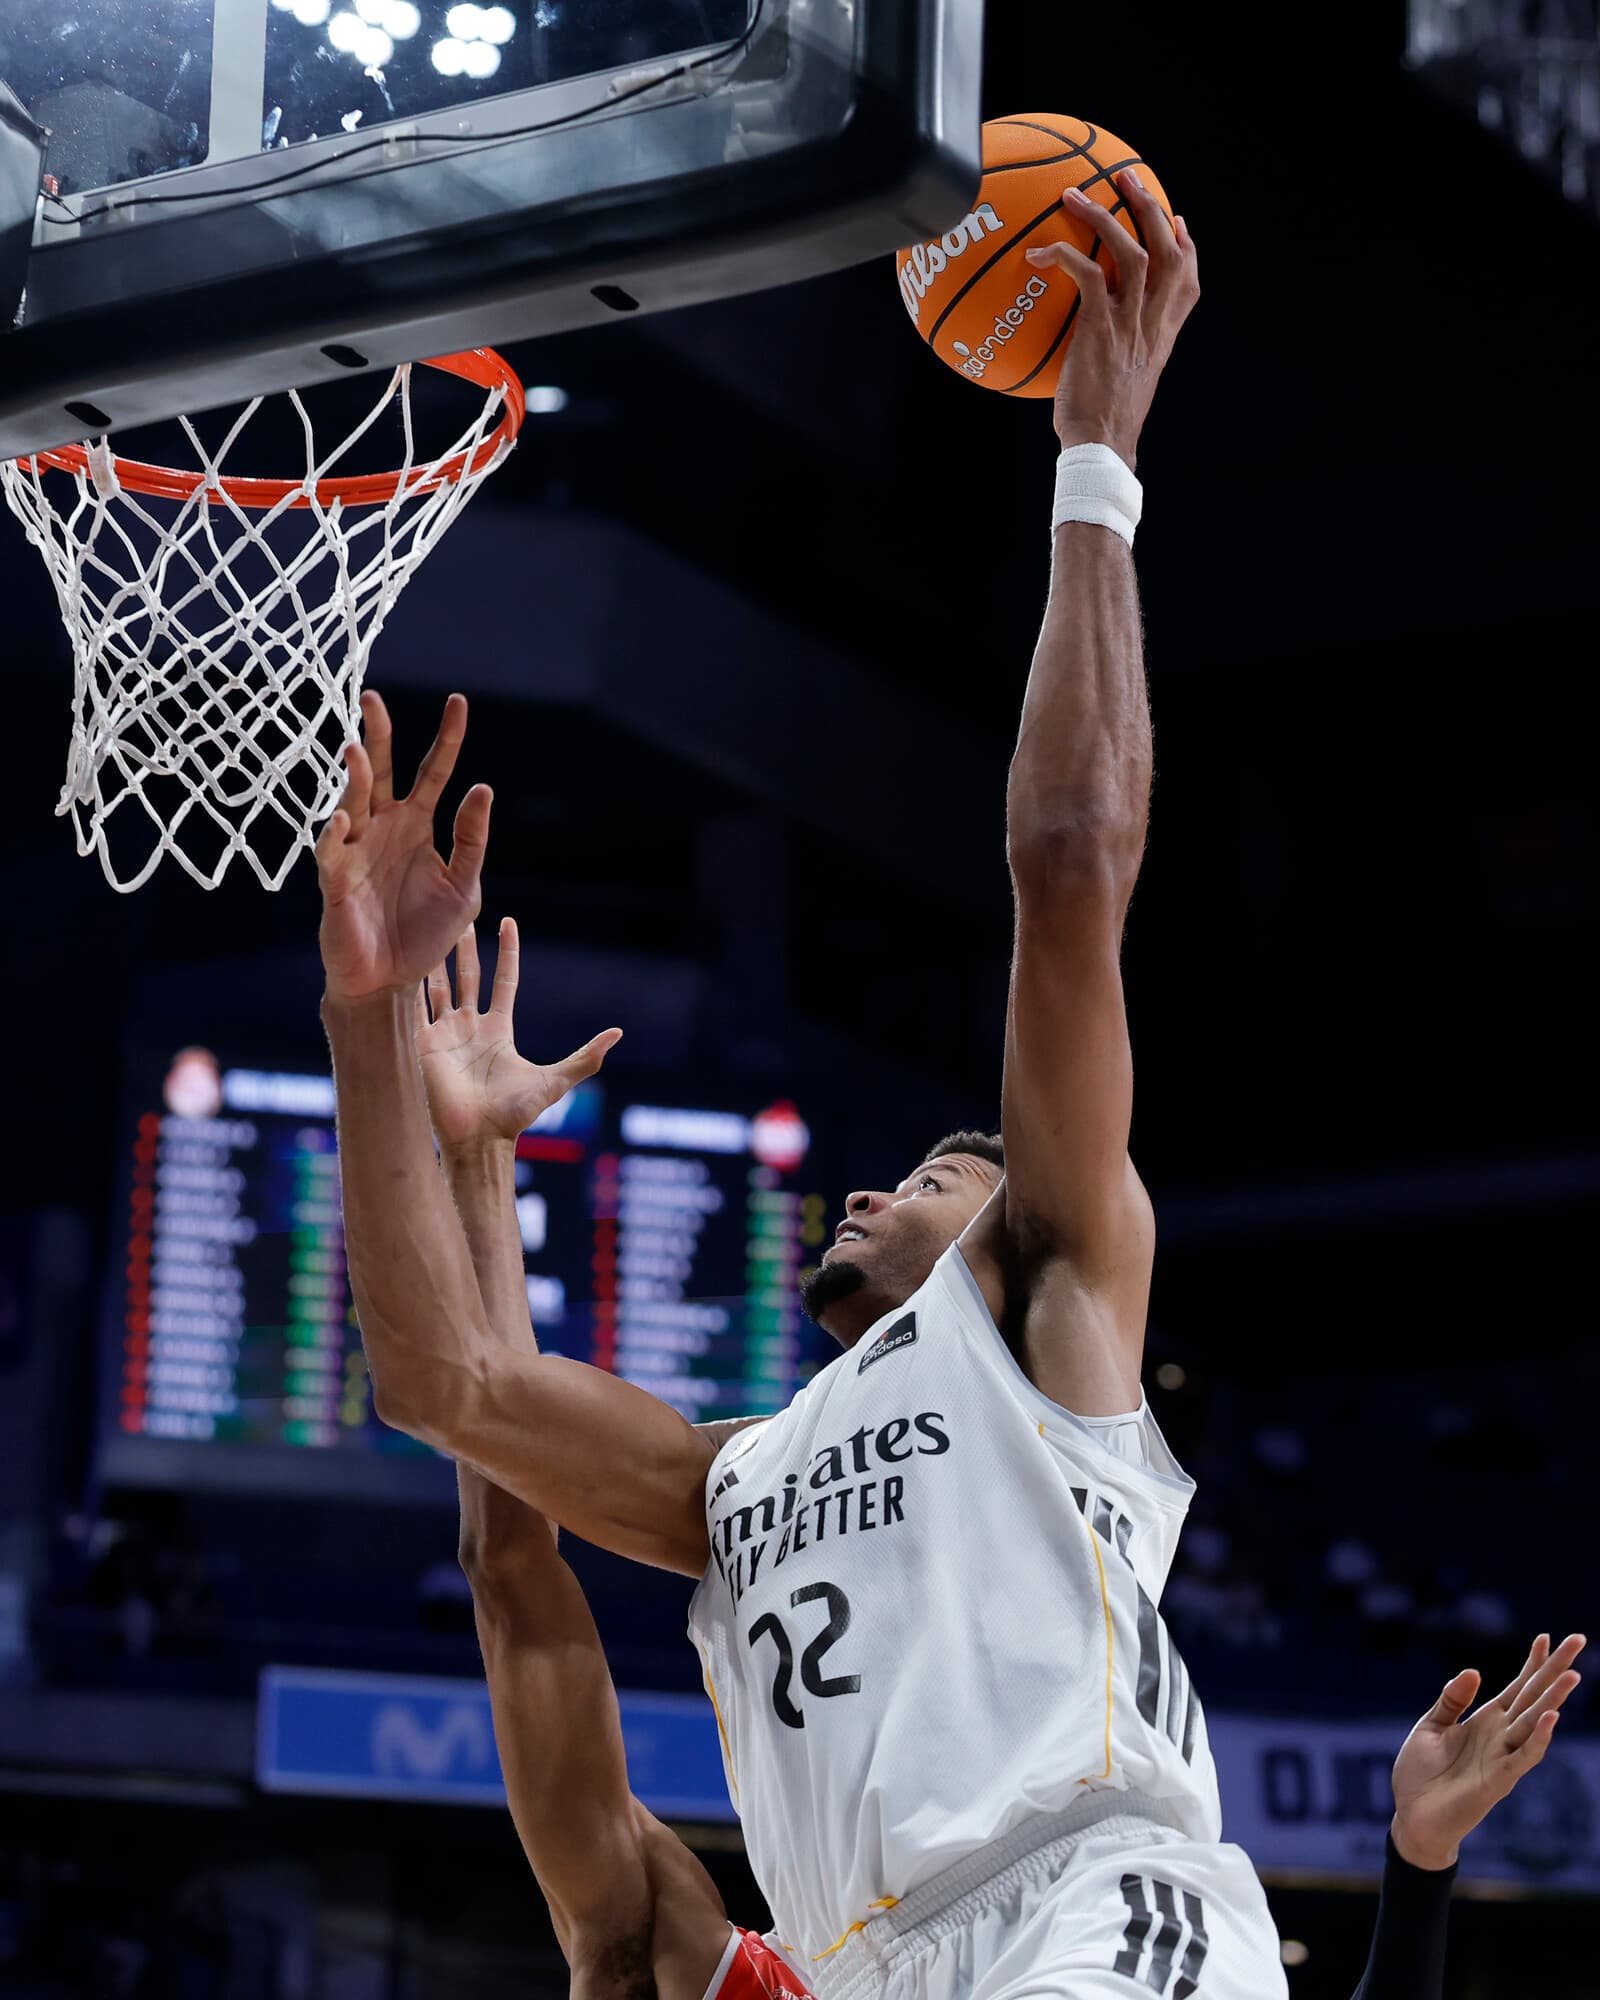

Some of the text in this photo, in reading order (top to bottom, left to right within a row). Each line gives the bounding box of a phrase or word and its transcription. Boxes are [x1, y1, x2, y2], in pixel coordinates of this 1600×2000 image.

[976, 275, 1049, 361] endesa
[712, 1412, 950, 1583] miates
[773, 1475, 905, 1568] BETTER
[748, 1581, 862, 1729] 22
